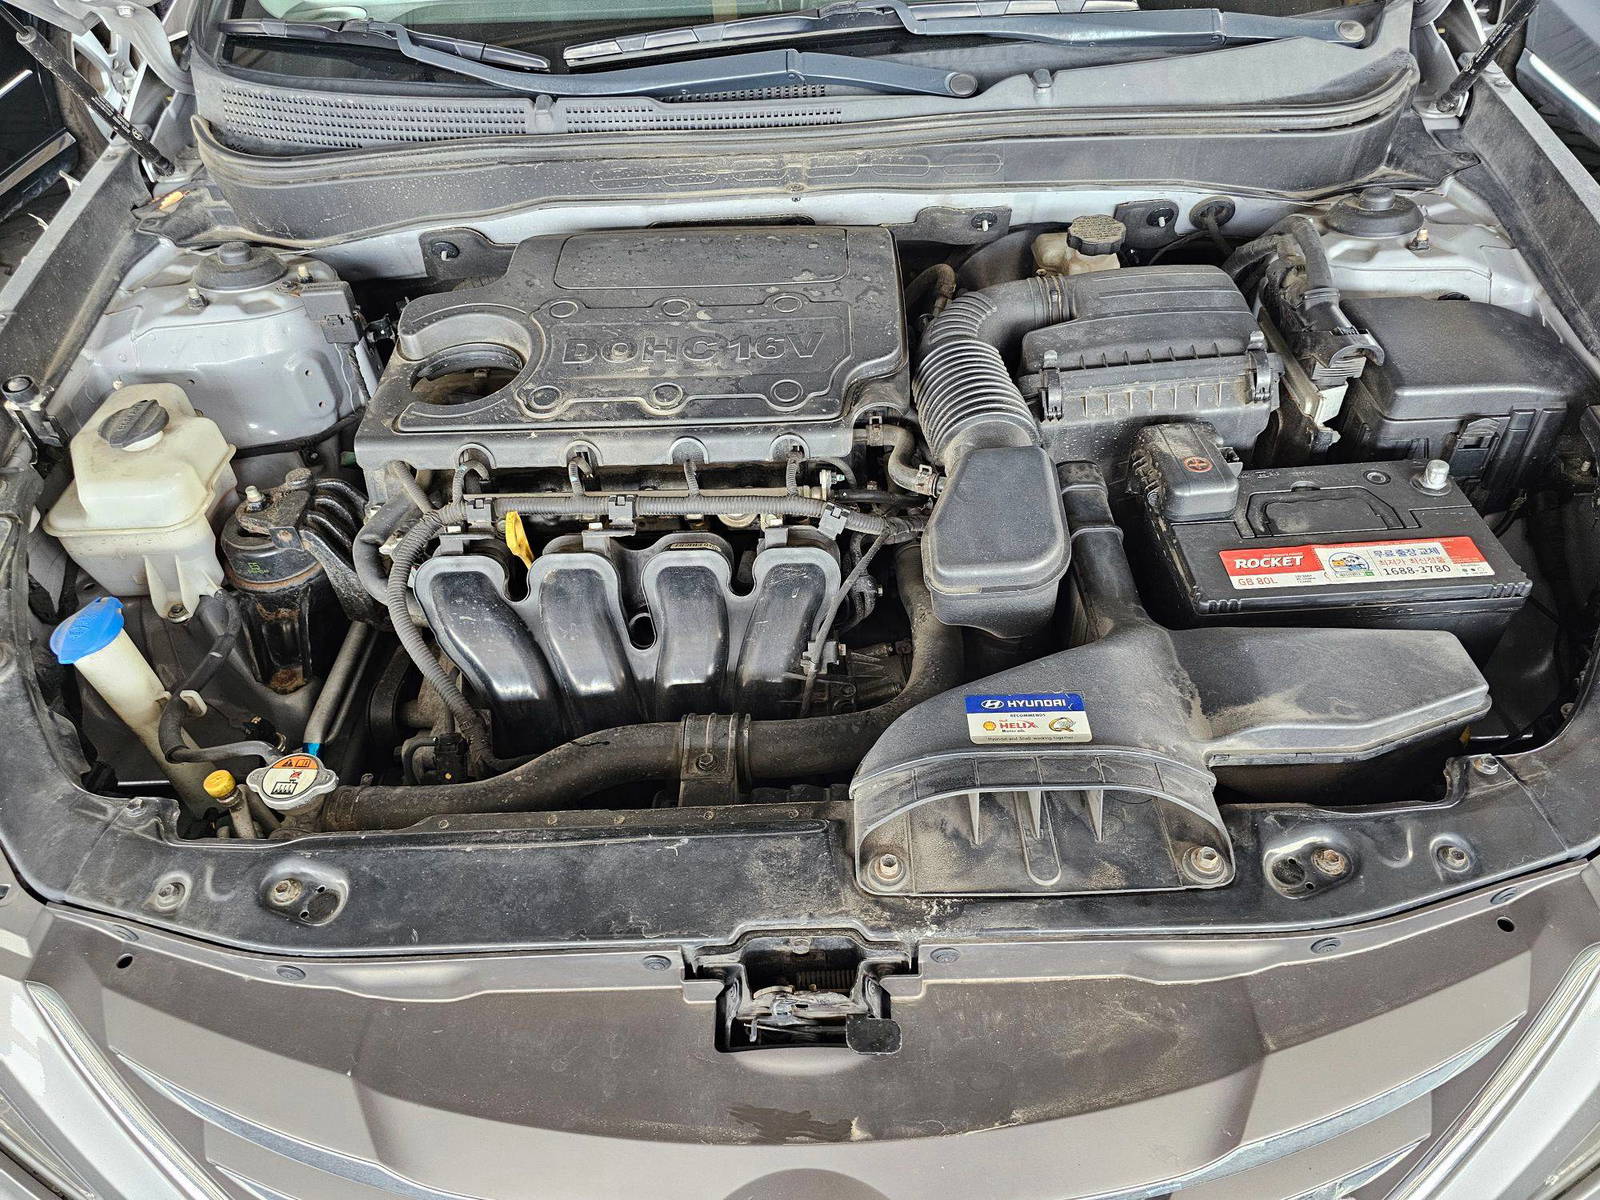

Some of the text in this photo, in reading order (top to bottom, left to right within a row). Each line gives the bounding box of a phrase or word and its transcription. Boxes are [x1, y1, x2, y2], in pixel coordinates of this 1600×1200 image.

[562, 331, 825, 364] DOHC 16V
[1233, 555, 1304, 569] ROCKET
[1383, 564, 1452, 576] 1688-3780
[1238, 576, 1278, 586] GB 80L
[1007, 699, 1066, 708] HYUNDAI
[1000, 721, 1038, 729] HELIX
